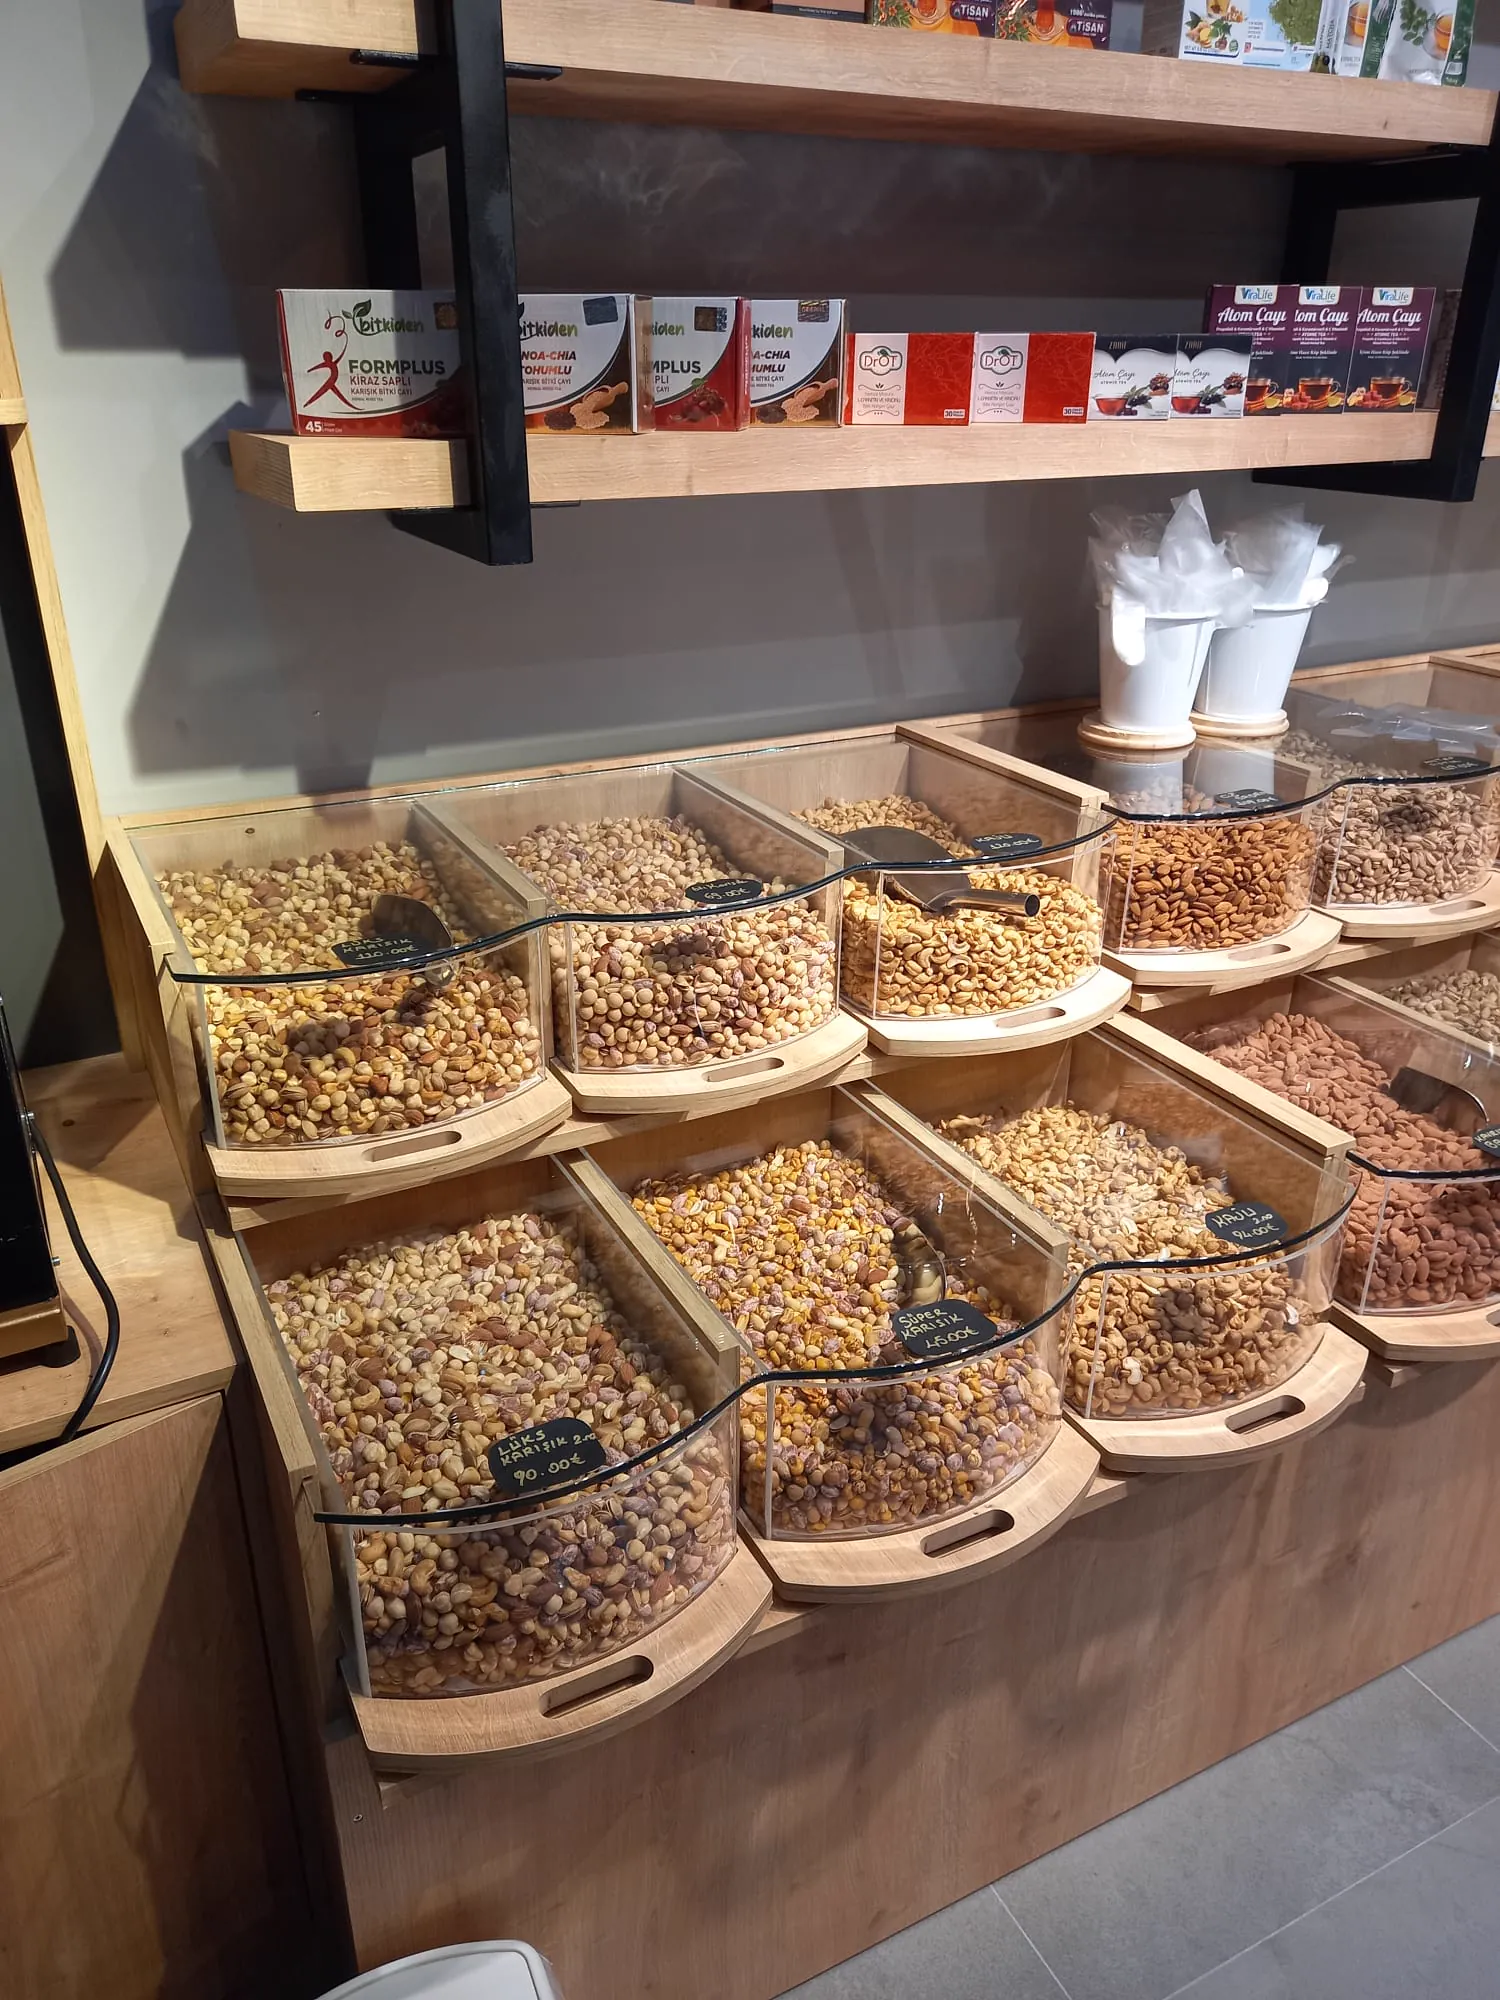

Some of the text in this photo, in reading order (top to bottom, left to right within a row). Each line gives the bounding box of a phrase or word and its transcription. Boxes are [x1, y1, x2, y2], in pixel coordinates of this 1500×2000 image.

[1241, 287, 1274, 300] ViraLife
[1305, 287, 1336, 301] ViraLife
[1378, 289, 1410, 302] ViraLife
[1217, 306, 1287, 326] Atom Çayı
[1294, 308, 1349, 327] tom Çayı
[1392, 308, 1423, 327] Çayı
[752, 322, 793, 339] kiden
[521, 350, 577, 361] NOA-CHIA
[348, 359, 447, 376] FORMPLUS
[653, 360, 702, 374] MPLUS
[305, 420, 322, 433] 45
[898, 1308, 949, 1329] SÜPER
[498, 1430, 546, 1457] LÜKS
